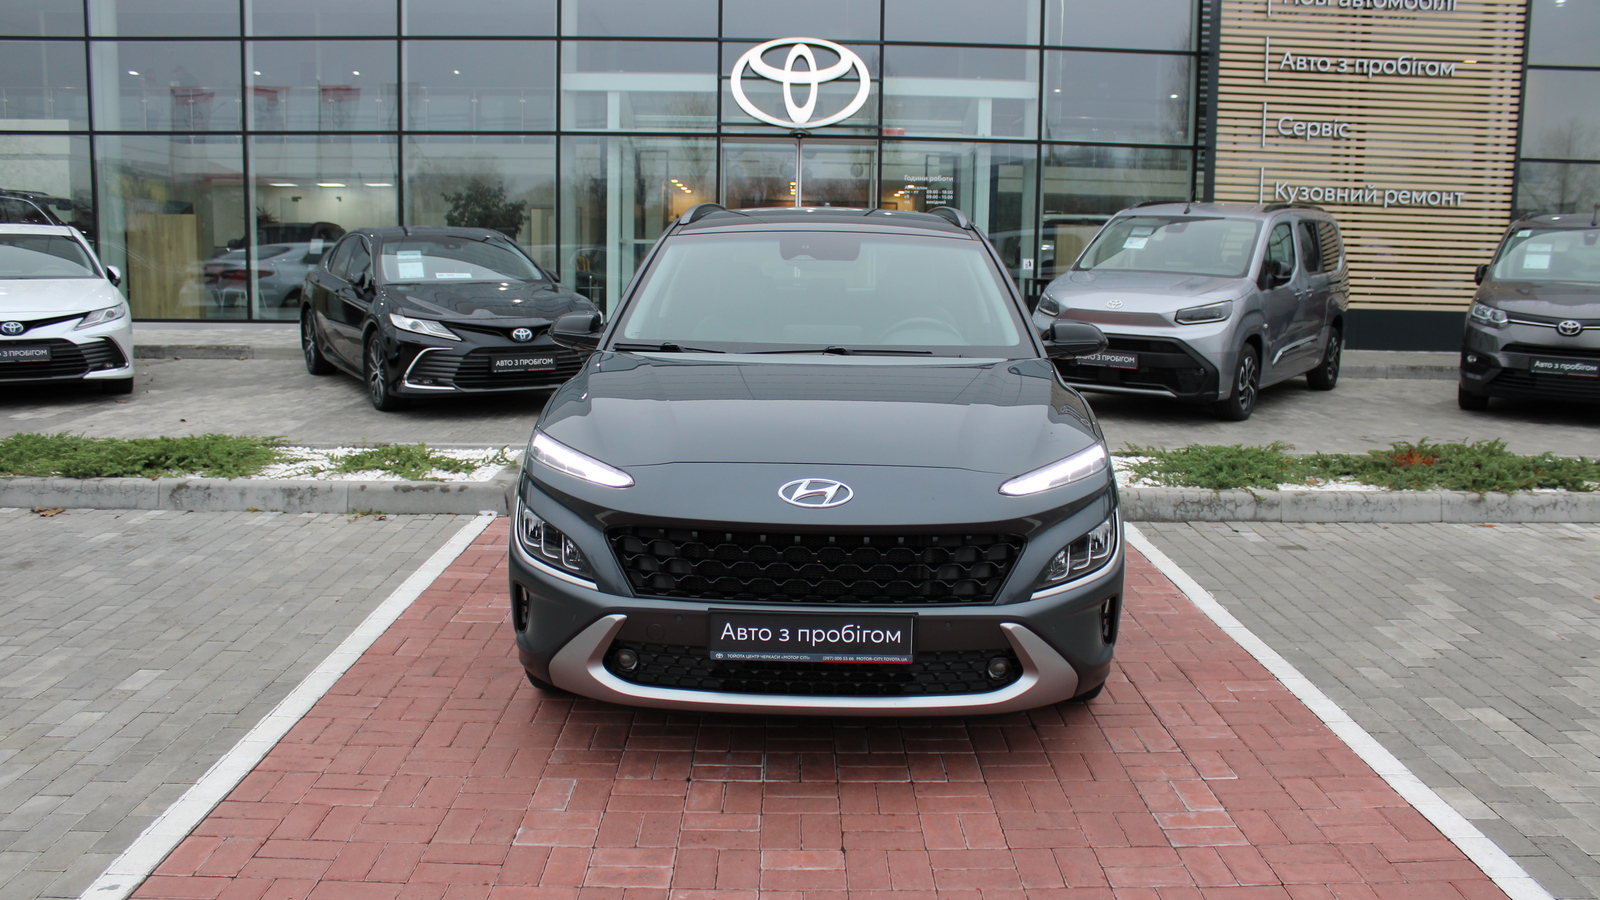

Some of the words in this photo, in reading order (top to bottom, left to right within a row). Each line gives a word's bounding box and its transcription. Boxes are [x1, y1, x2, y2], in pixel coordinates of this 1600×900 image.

[1279, 51, 1331, 71] Авто
[1336, 57, 1348, 72] з
[1355, 55, 1456, 78] пробігом
[1277, 116, 1351, 141] Сервіс
[1274, 181, 1377, 205] Кузовний
[1383, 189, 1465, 208] ремонт
[495, 359, 513, 367] АВТО
[519, 358, 553, 366] ПРОБІГОМ
[1102, 354, 1135, 363] ПРОБІГОМ
[1534, 360, 1553, 369] Авто
[1560, 362, 1598, 371] пробігом
[720, 622, 772, 642] Авто
[778, 627, 790, 642] з
[797, 624, 901, 647] пробігом
